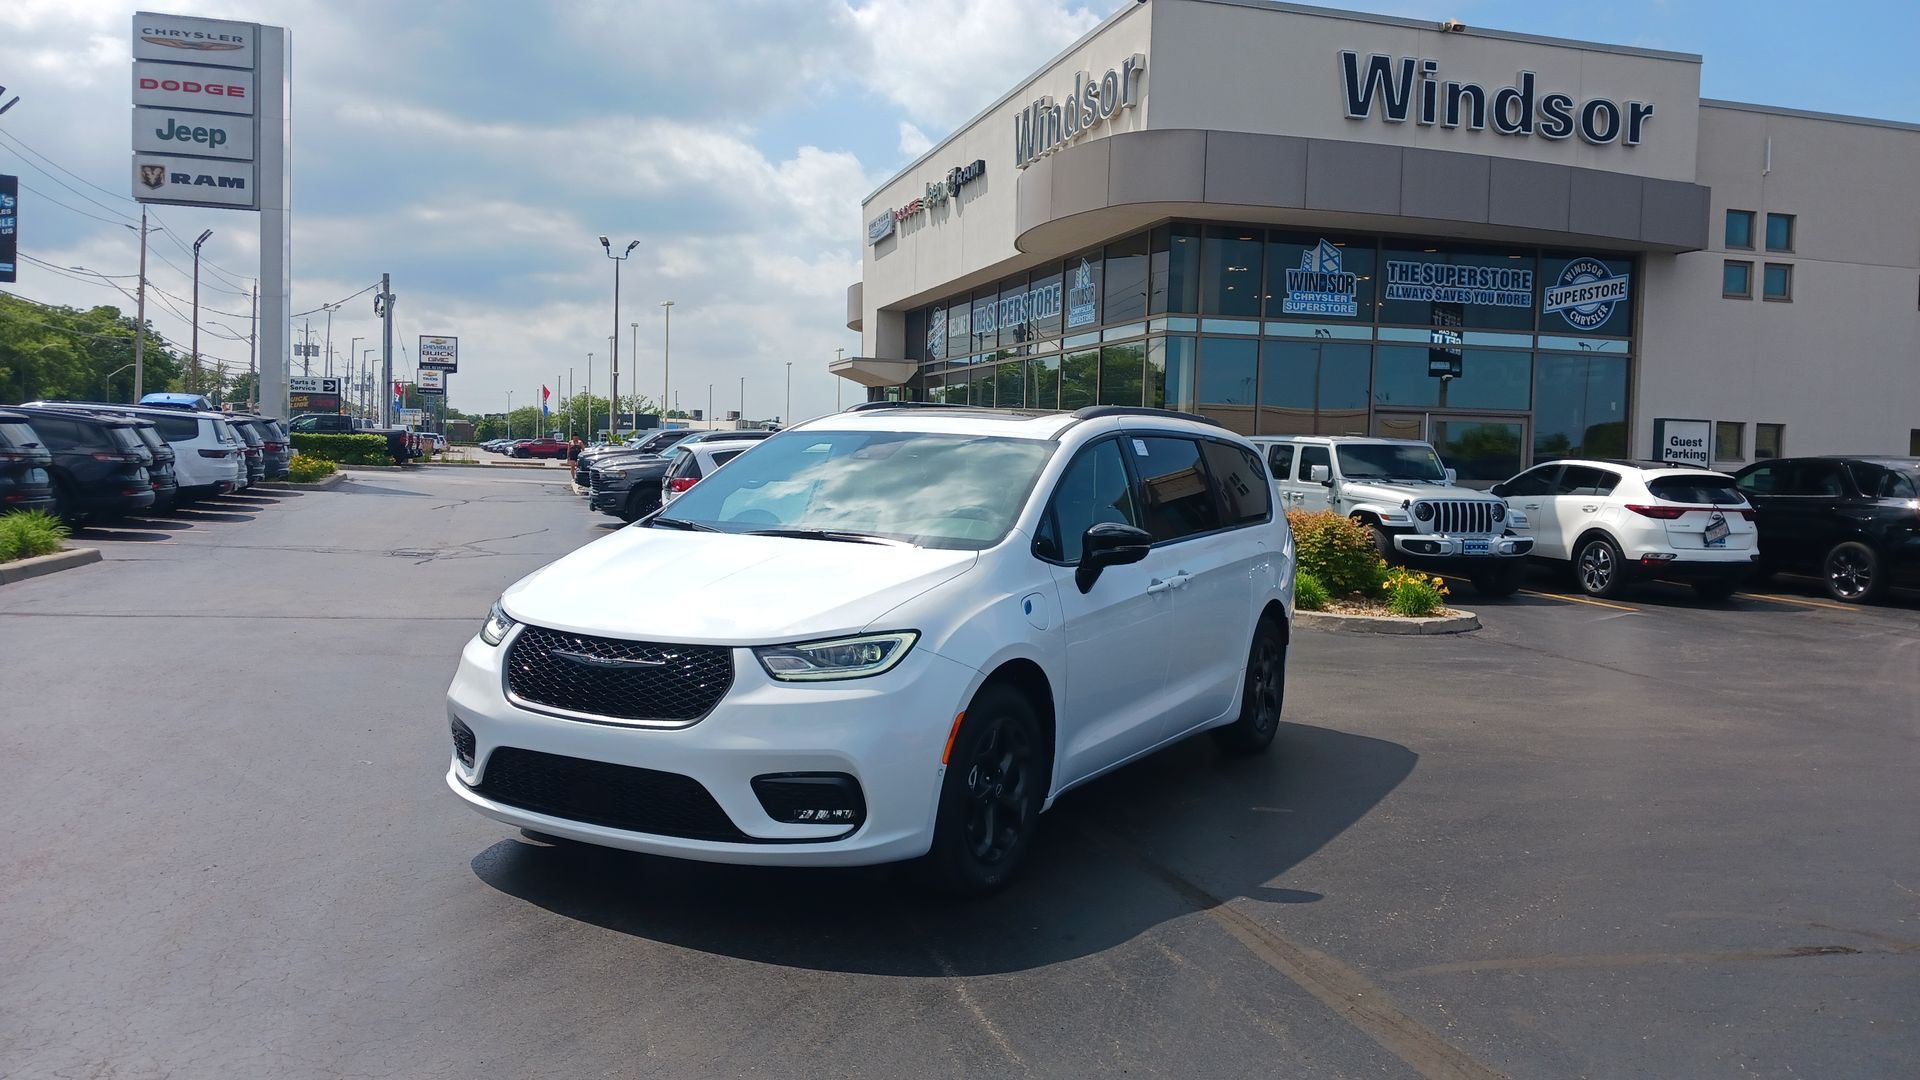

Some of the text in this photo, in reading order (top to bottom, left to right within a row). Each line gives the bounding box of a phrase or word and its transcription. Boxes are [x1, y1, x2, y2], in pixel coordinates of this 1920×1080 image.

[142, 27, 244, 43] CHRYSLER
[139, 78, 246, 98] DODGE
[1337, 50, 1654, 145] Windsor
[1014, 53, 1145, 170] Windsor
[155, 118, 227, 148] Jeep
[170, 172, 245, 189] RAM
[1288, 271, 1354, 294] WINDSOR
[1388, 262, 1531, 289] THE SUPERSTORE
[1564, 262, 1604, 283] WINDSOR
[1293, 292, 1348, 303] CHRYSLER
[1387, 285, 1531, 306] ALWAYS SAVES YOU MORE!
[1547, 281, 1626, 307] SUPERSTORE
[1286, 301, 1354, 313] SUPERSTORE
[1569, 304, 1609, 326] CHRYSLER
[290, 384, 317, 392] Service
[1670, 436, 1703, 448] Guest
[1665, 447, 1707, 462] Parking
